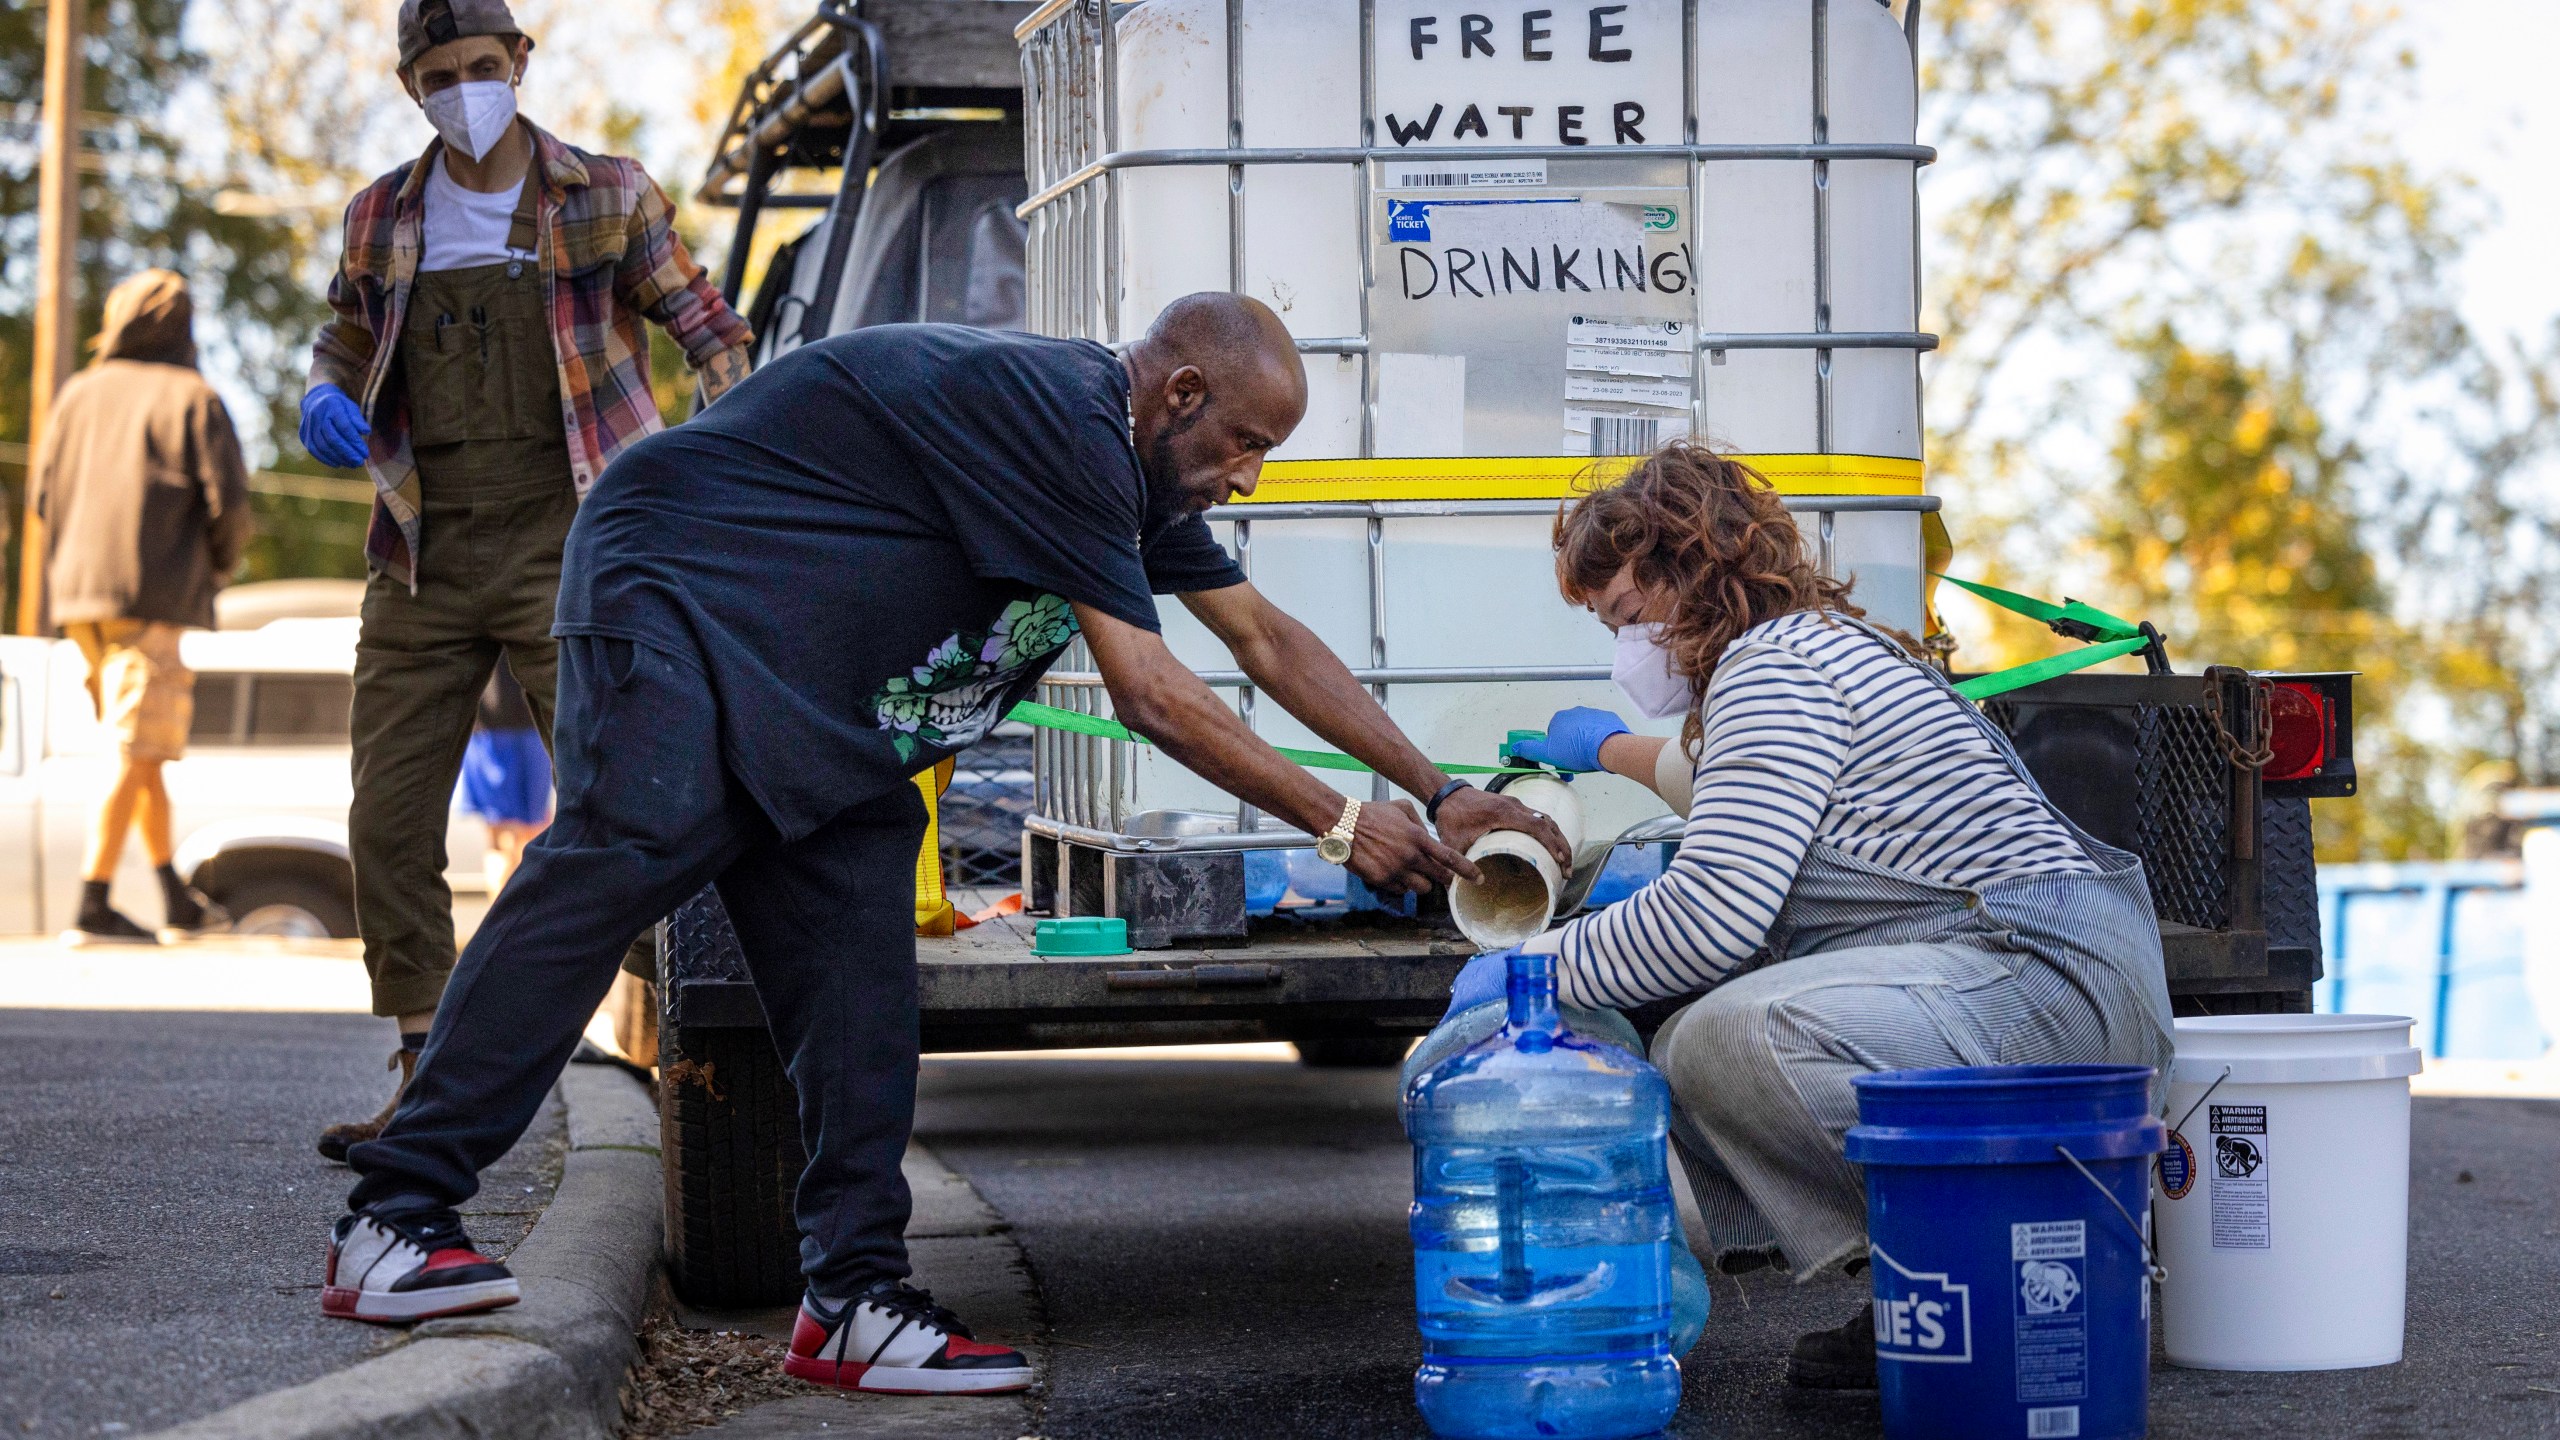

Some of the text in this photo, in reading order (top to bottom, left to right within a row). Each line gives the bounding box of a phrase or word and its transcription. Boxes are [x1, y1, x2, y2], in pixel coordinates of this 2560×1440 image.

[1410, 4, 1633, 63] FREE
[1385, 101, 1646, 147] WATER
[1396, 220, 1425, 229] TICKET
[1652, 389, 1683, 397] 23-08-2023
[2221, 1107, 2264, 1115] WARNING
[2221, 1116, 2264, 1124] AVERTISSEMENT
[2221, 1124, 2264, 1132] ADVERTENCIA
[2030, 1223, 2082, 1234] WARNING
